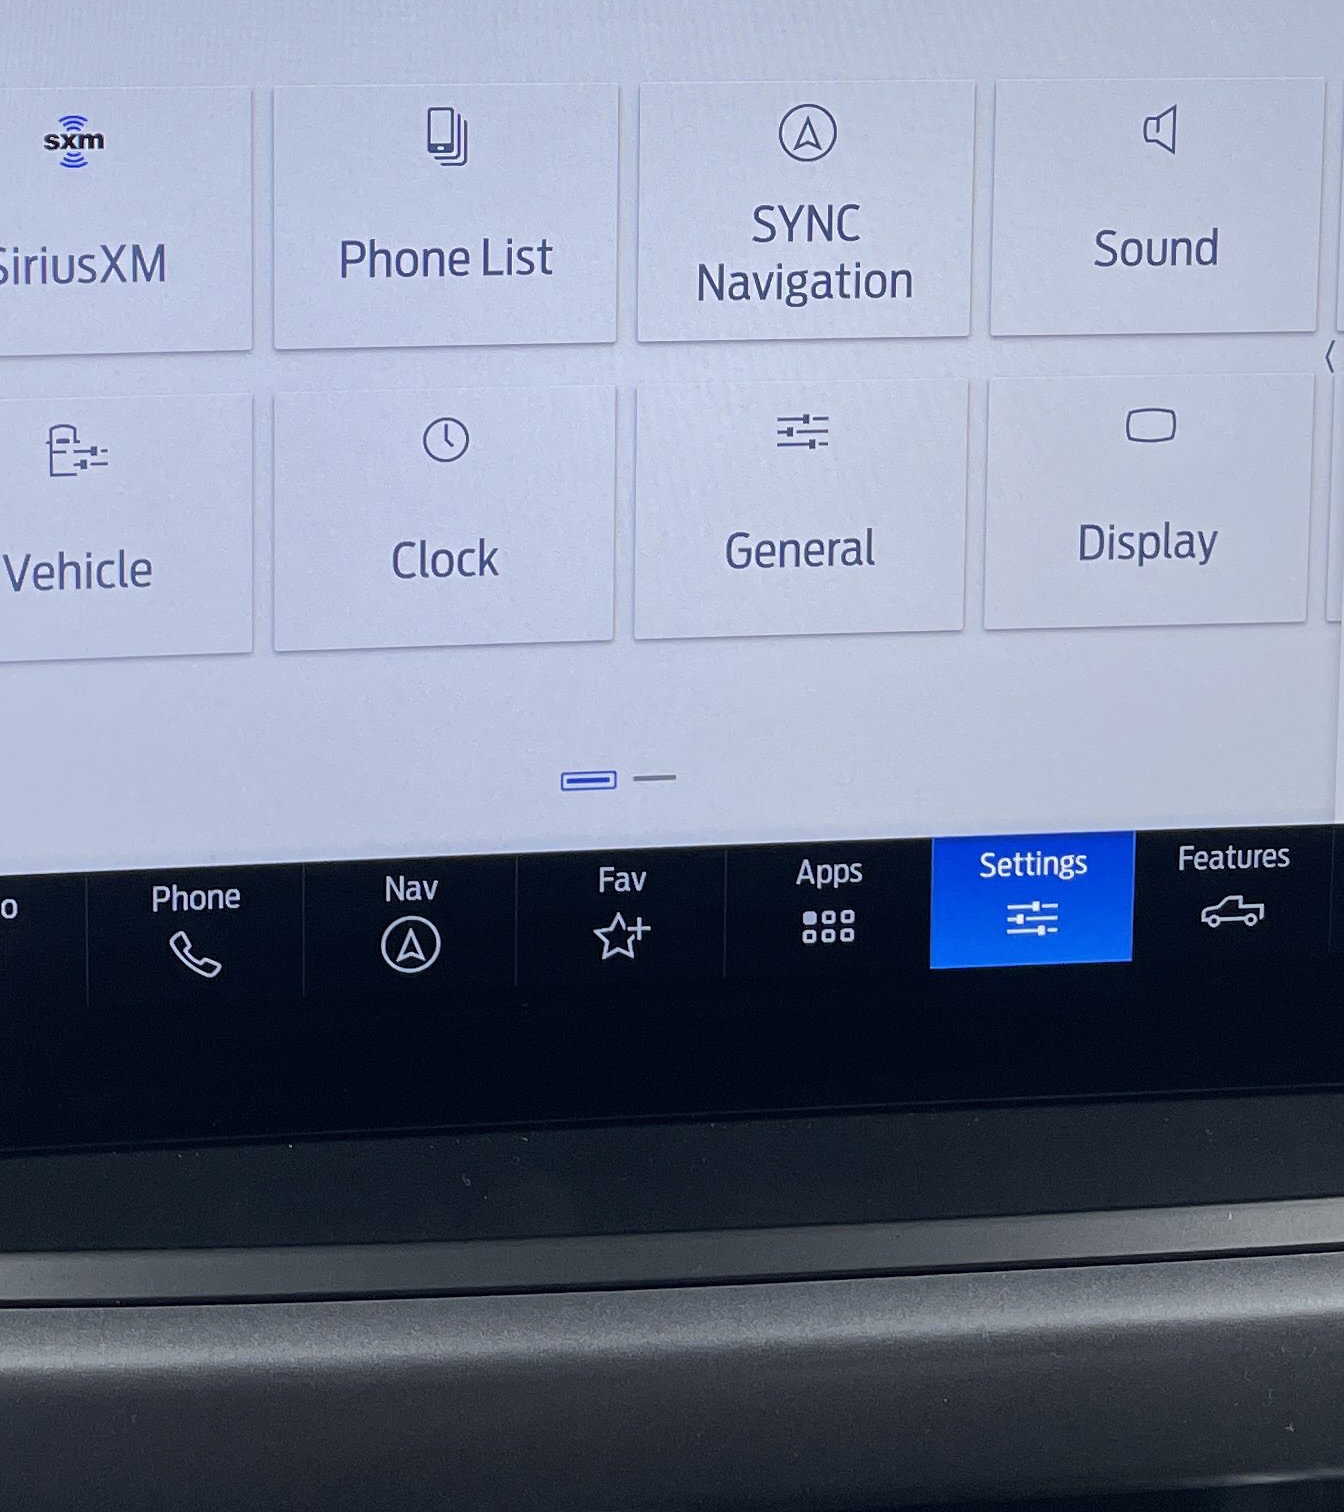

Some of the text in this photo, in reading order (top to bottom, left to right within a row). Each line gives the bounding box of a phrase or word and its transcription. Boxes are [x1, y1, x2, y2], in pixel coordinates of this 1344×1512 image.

[44, 131, 104, 150] sxm
[752, 204, 860, 242] SYNC
[342, 238, 553, 278] Phone List
[1095, 228, 1218, 266] Sound
[699, 262, 911, 307] Navigation
[393, 538, 498, 578] Clock
[727, 528, 875, 569] General
[1080, 522, 1218, 567] Display
[3, 550, 151, 592] Vehicle
[796, 859, 863, 888] Apps
[980, 851, 1087, 879] Settings
[1179, 845, 1290, 870] Features
[153, 884, 240, 912] Phone
[386, 876, 438, 901] Nav
[600, 867, 646, 892] Fav
